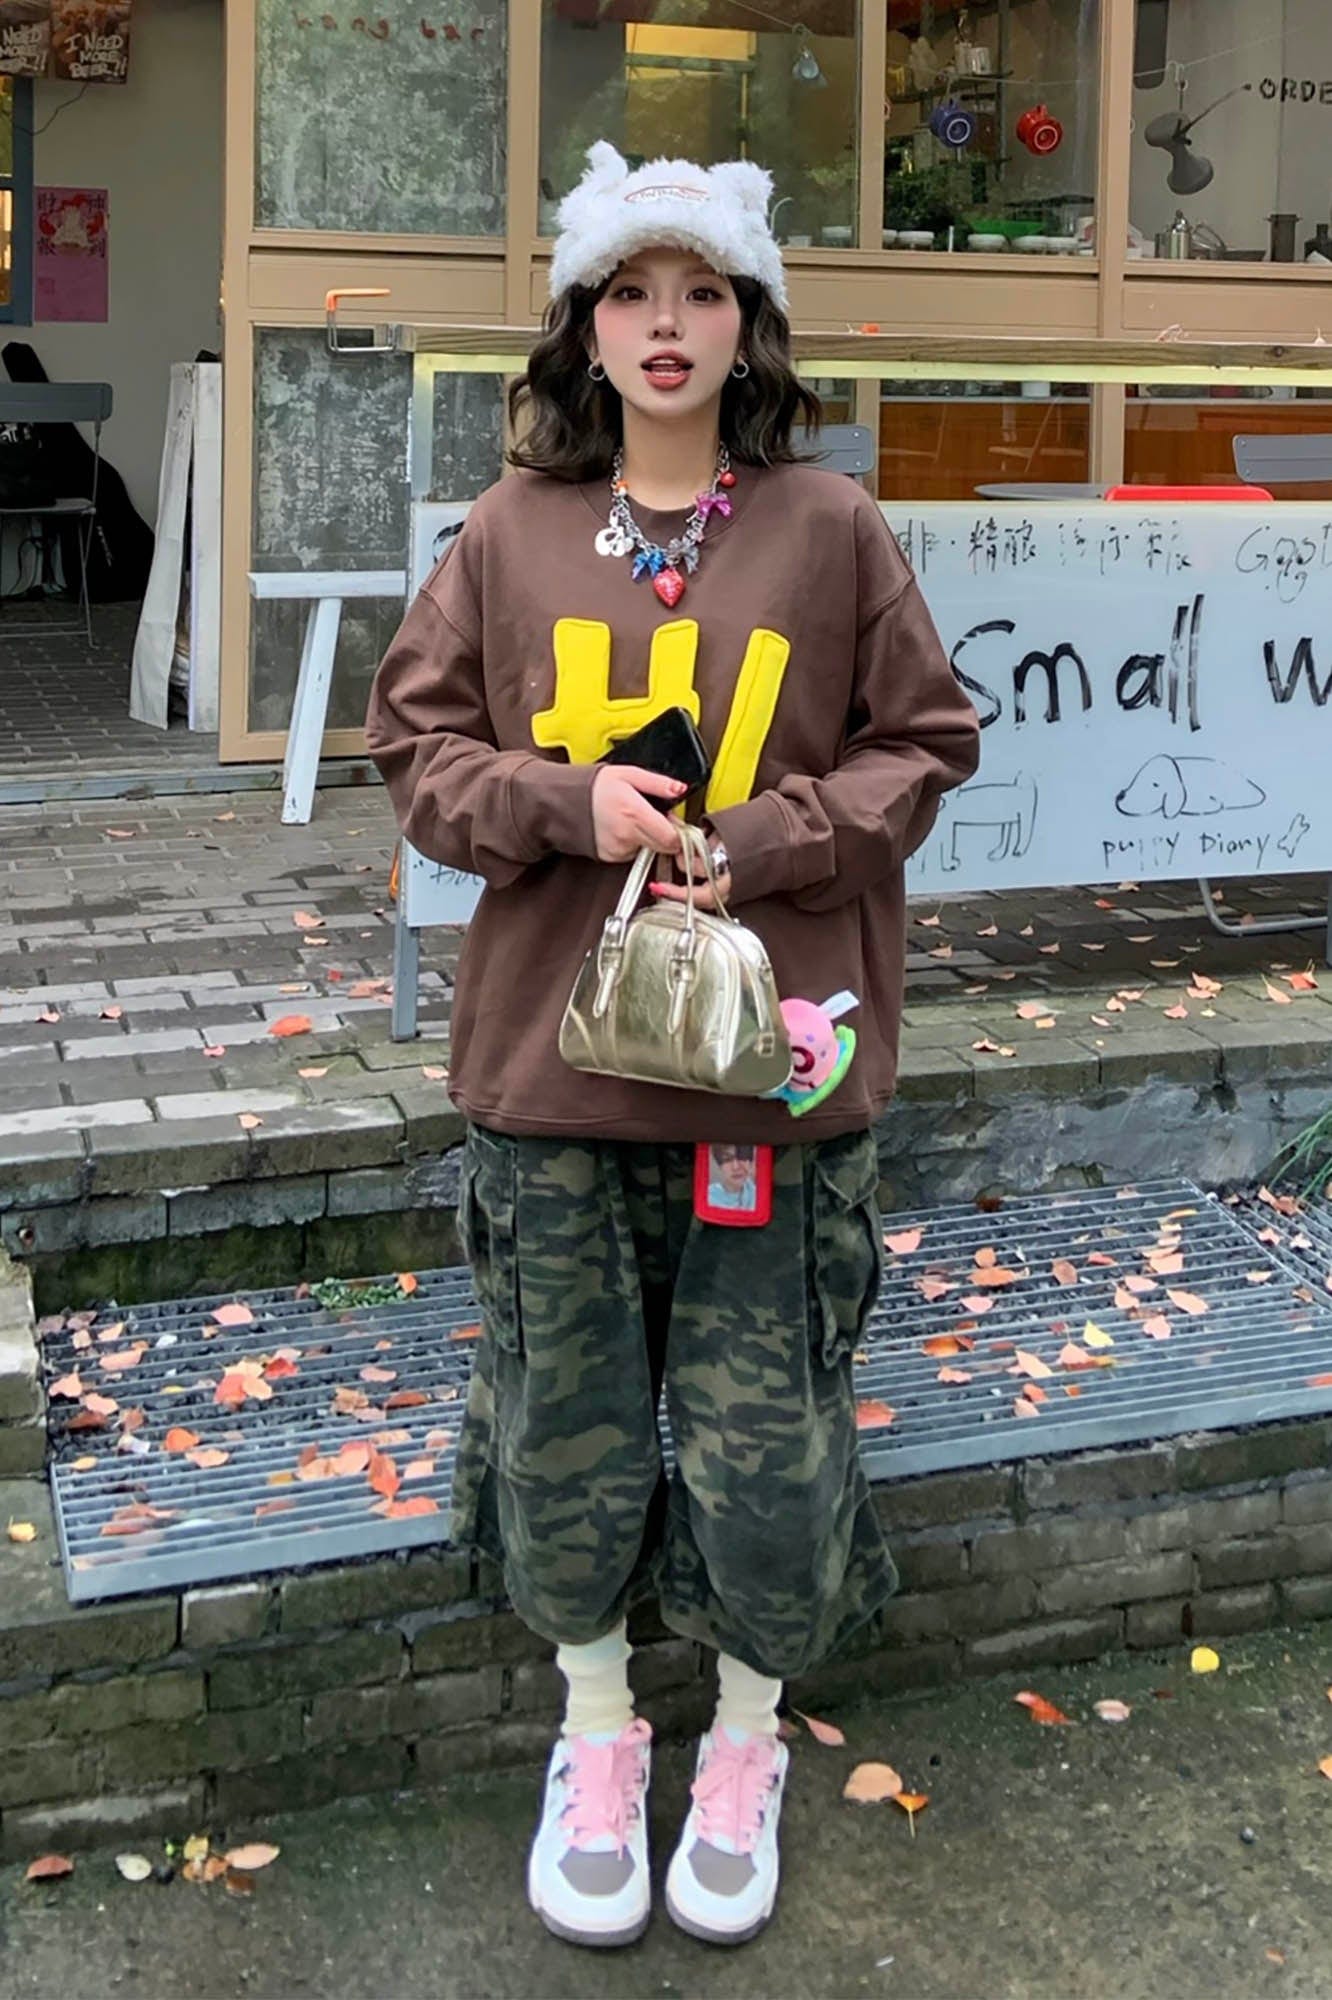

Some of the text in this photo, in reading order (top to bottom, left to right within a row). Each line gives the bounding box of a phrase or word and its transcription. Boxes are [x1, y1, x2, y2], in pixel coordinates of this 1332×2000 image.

[63, 31, 125, 54] I NEED
[79, 50, 122, 64] MORE
[950, 593, 1205, 732] Small
